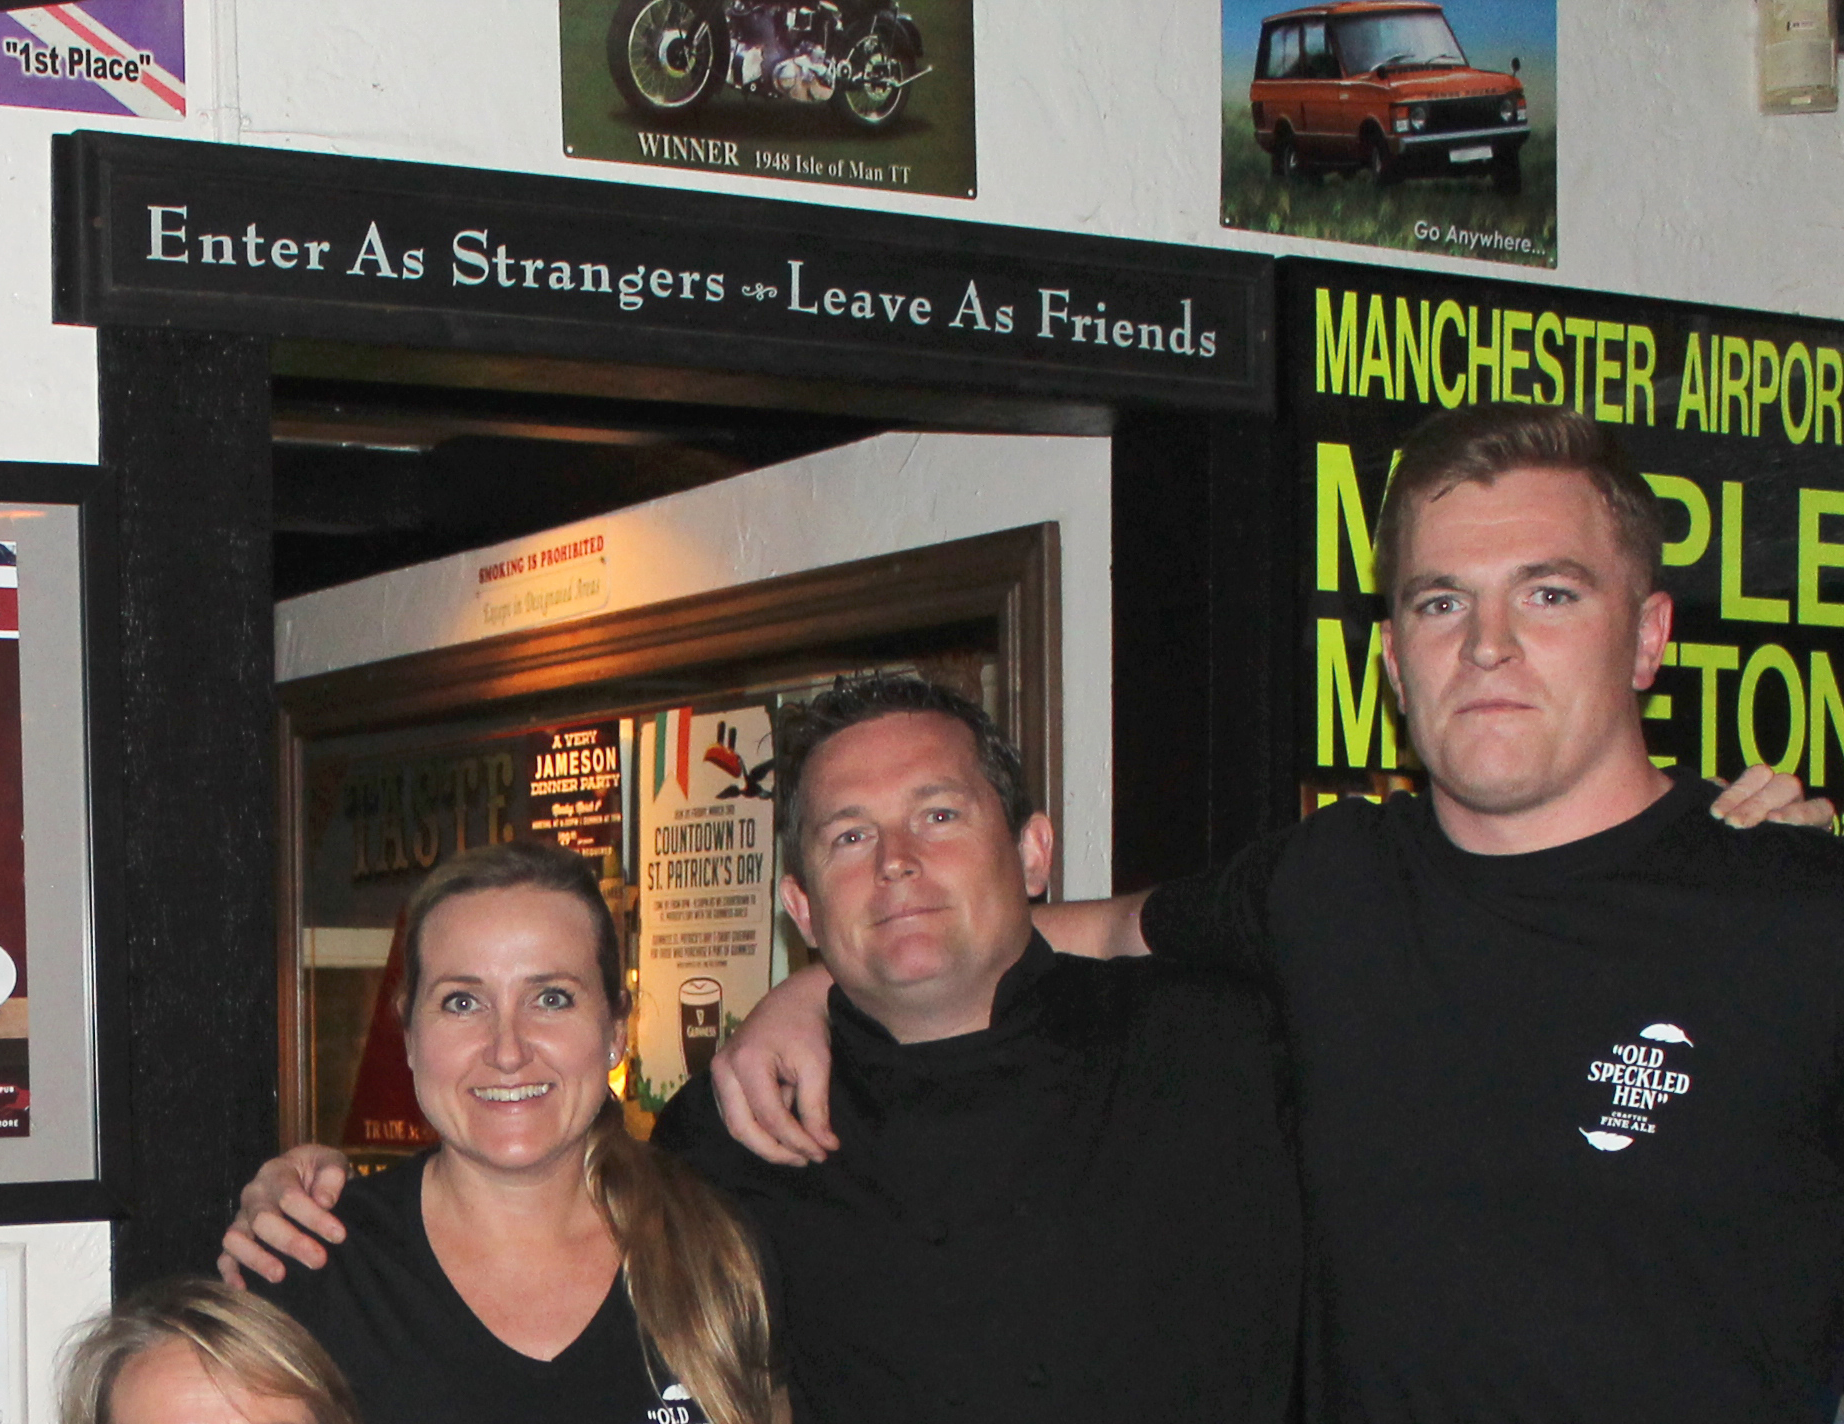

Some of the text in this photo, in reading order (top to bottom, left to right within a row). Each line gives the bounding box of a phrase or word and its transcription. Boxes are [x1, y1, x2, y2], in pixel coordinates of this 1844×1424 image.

[5, 41, 151, 82] "1st Place"
[638, 131, 911, 184] WINNER 1948 Isle of Man TT
[1414, 220, 1546, 255] Go Anywhere...
[145, 205, 1217, 359] Enter As Strangers Leave As Friends
[1316, 287, 1656, 427] MANCHESTER
[479, 535, 604, 584] SMOKING IS PROHIBITED
[552, 730, 597, 749] A VERY
[535, 746, 616, 779] JAMESON
[531, 773, 620, 796] DINNER PARTY
[655, 818, 755, 856] COUNTDOWN TO
[648, 853, 763, 890] ST. PATRICK'S DAY
[1587, 1061, 1690, 1094] SPECKLED
[1600, 1116, 1656, 1133] FINE ALE
